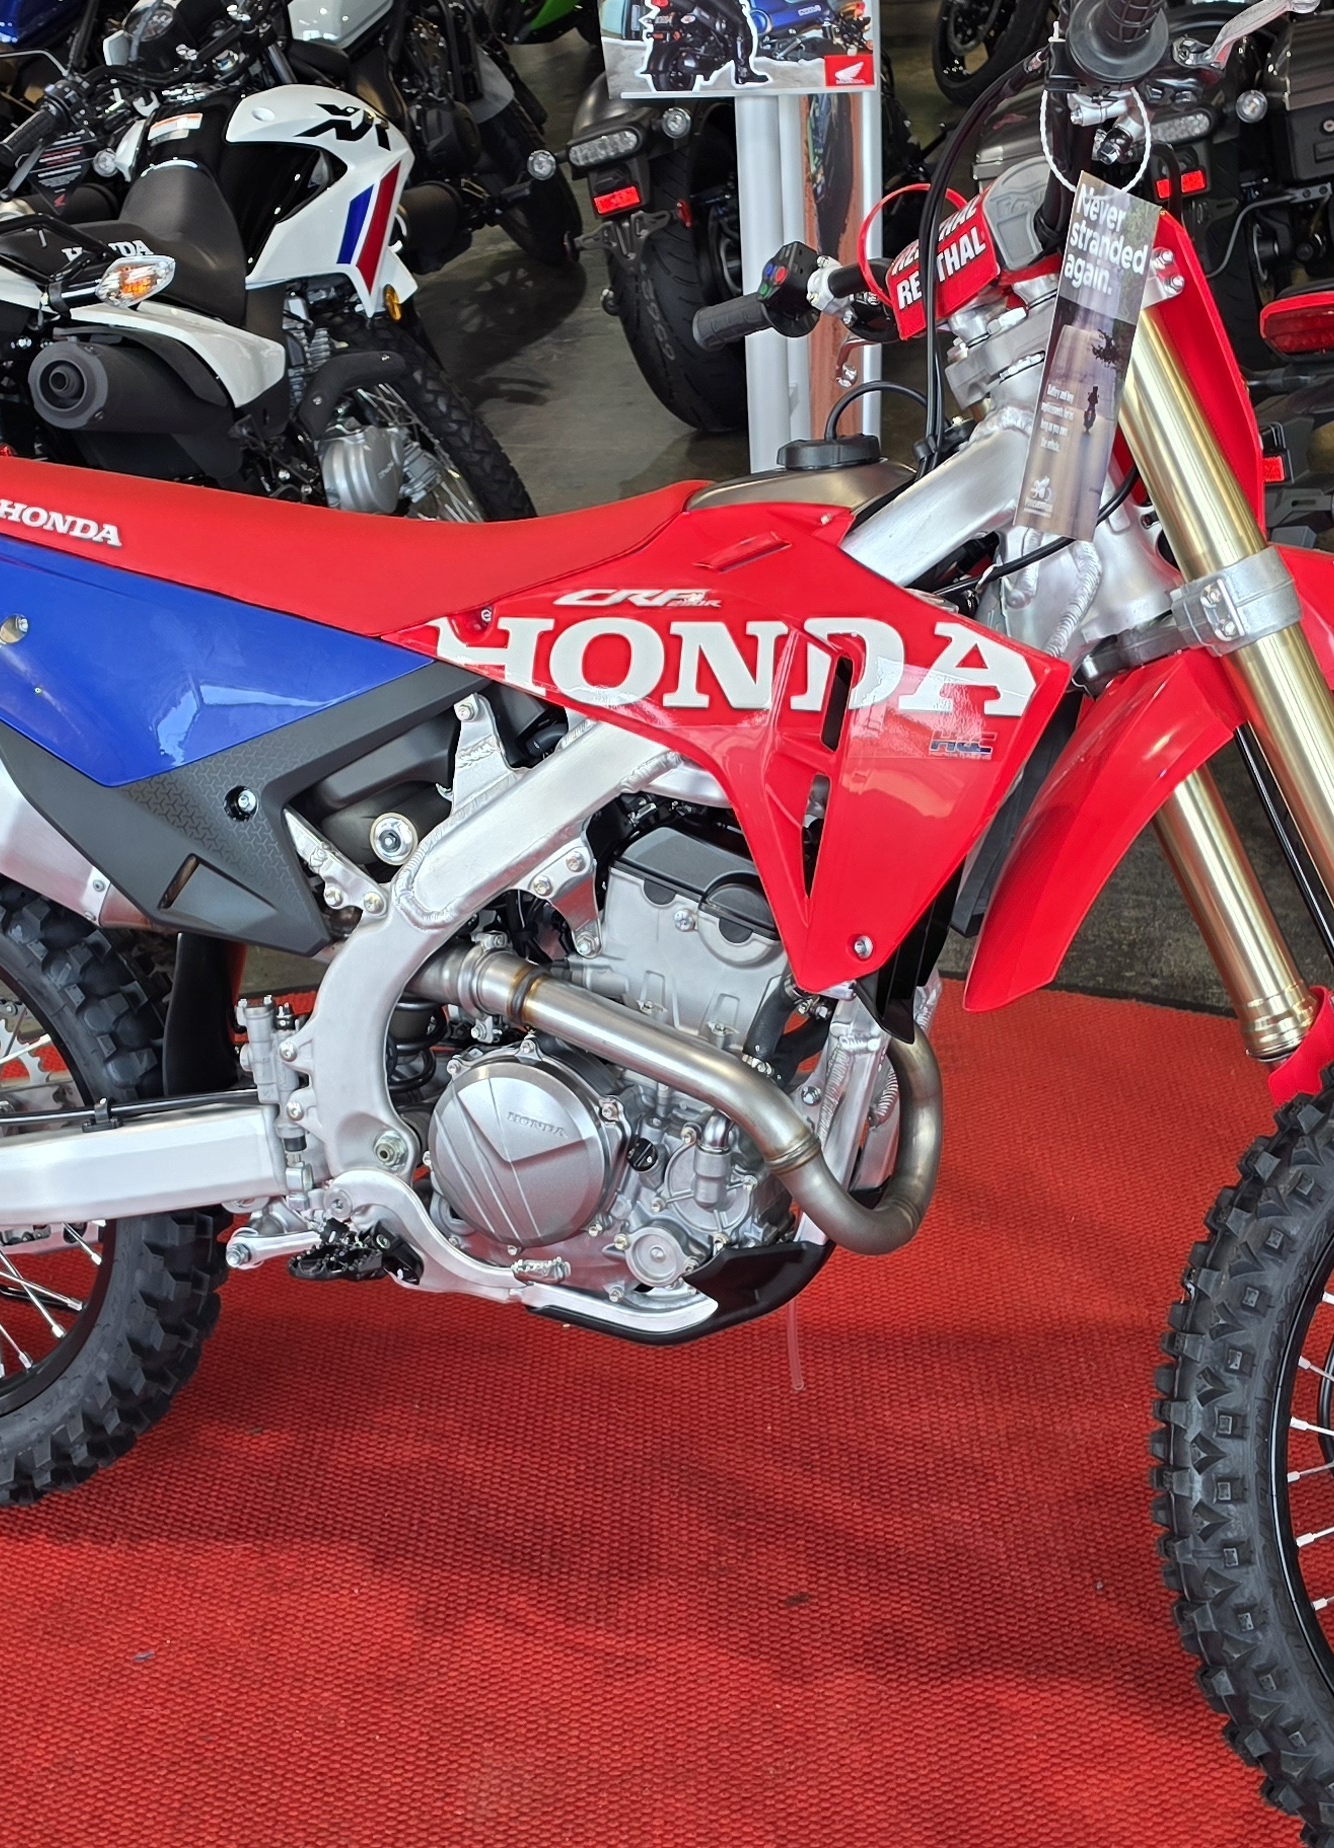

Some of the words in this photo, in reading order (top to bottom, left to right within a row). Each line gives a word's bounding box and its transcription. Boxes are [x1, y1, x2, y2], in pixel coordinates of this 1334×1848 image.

[1076, 183, 1127, 232] Never
[896, 226, 987, 311] RETHAL
[1069, 219, 1149, 275] stranded
[1064, 252, 1112, 295] again.
[553, 589, 711, 607] CRF
[422, 616, 1039, 716] HONDA
[507, 1111, 569, 1139] HONDA
